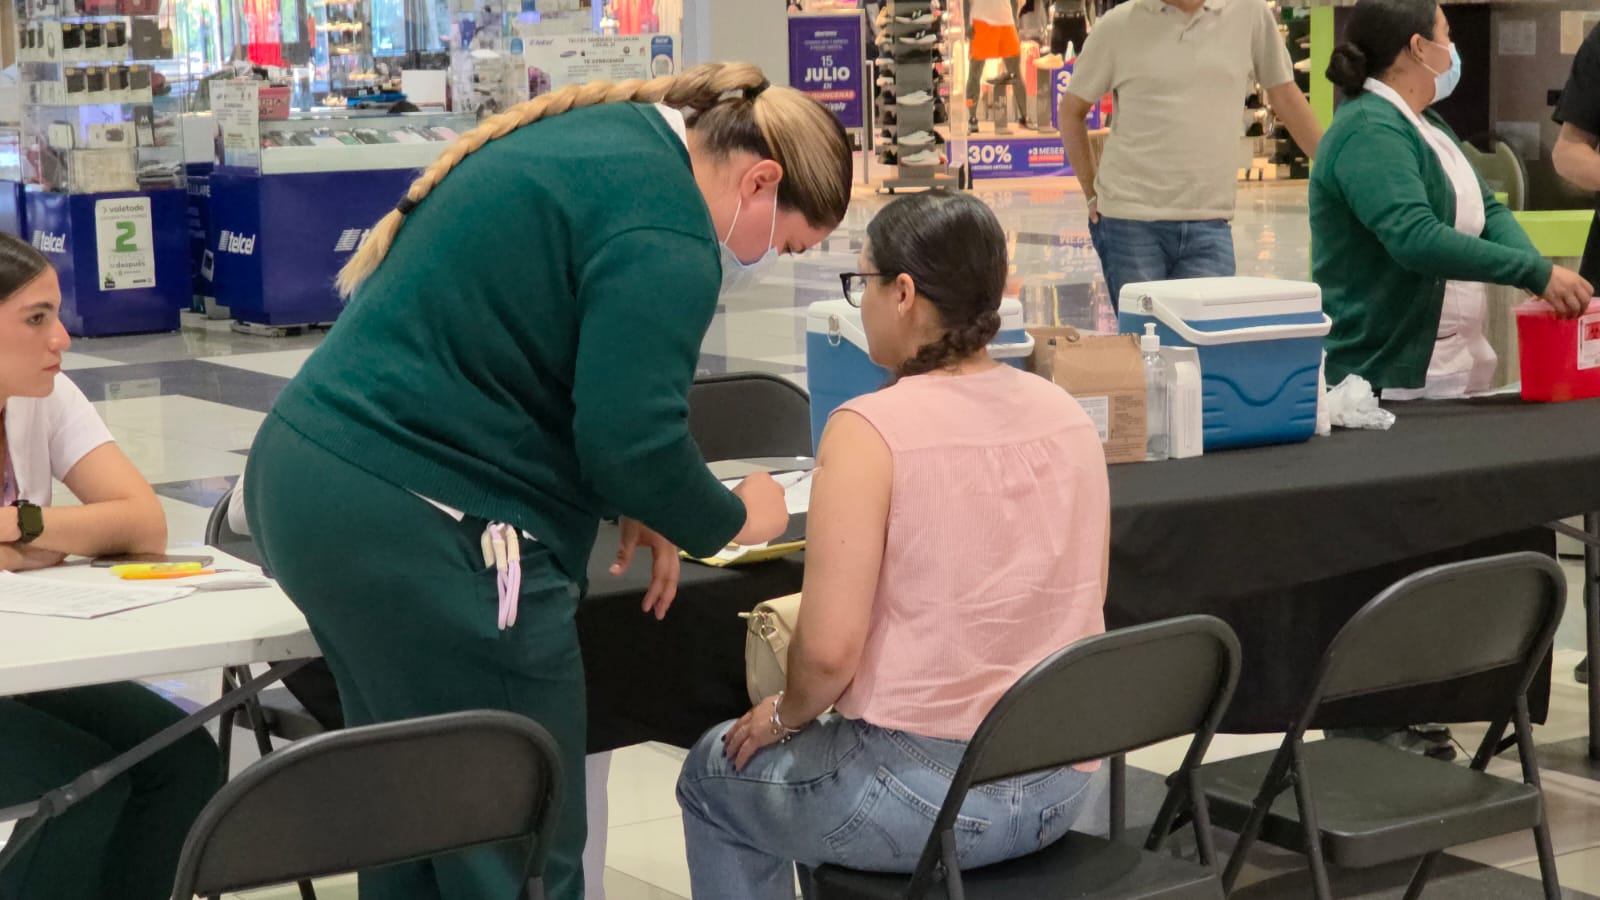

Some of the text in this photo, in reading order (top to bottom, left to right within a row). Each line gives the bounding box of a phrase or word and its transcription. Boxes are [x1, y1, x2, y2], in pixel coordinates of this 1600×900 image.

[821, 55, 834, 67] 15
[804, 66, 851, 82] JULIO
[968, 144, 1012, 164] 30%
[1039, 146, 1065, 155] MESES
[41, 231, 66, 253] telcel
[115, 221, 138, 252] 2
[228, 231, 256, 255] telcel
